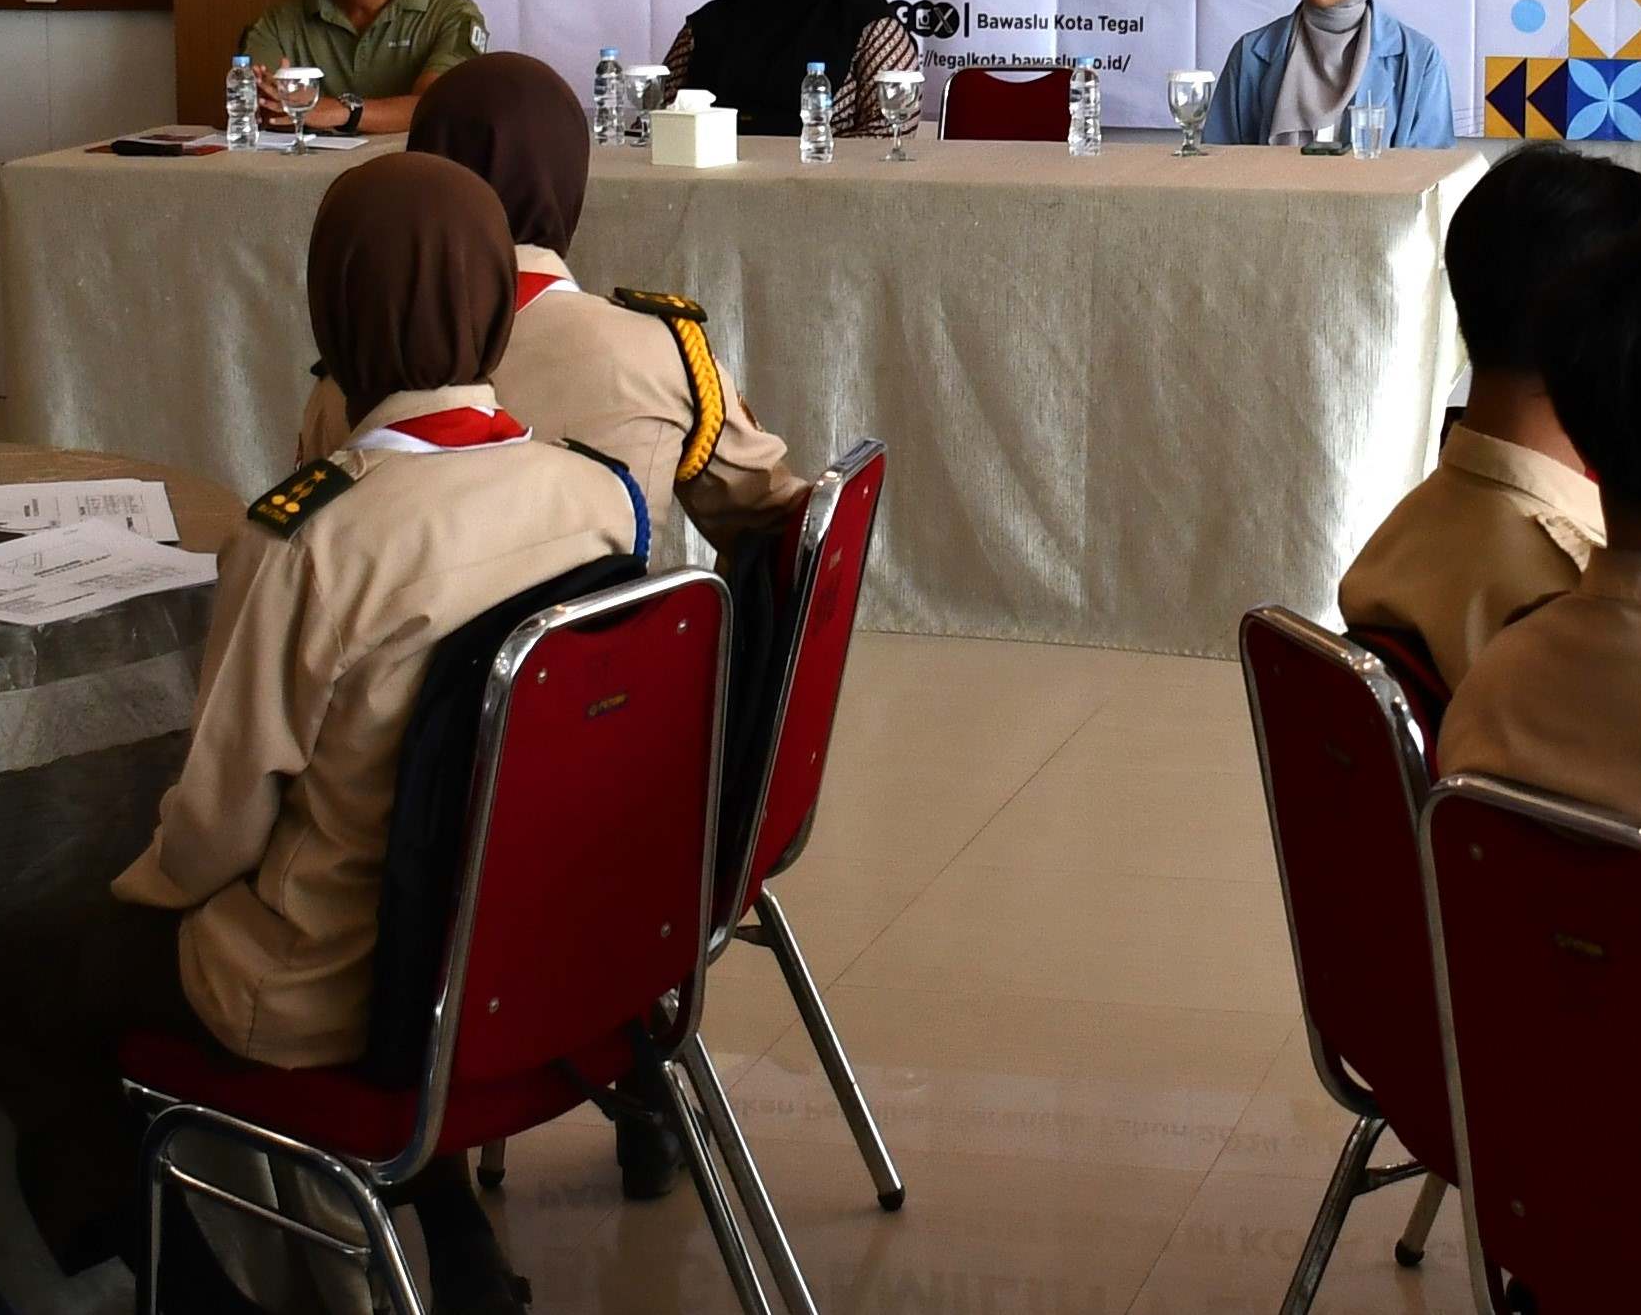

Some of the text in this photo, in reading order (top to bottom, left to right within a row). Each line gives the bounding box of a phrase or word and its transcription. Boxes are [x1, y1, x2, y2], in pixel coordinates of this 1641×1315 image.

[977, 13, 1144, 33] Bawaslu Kota Tegal
